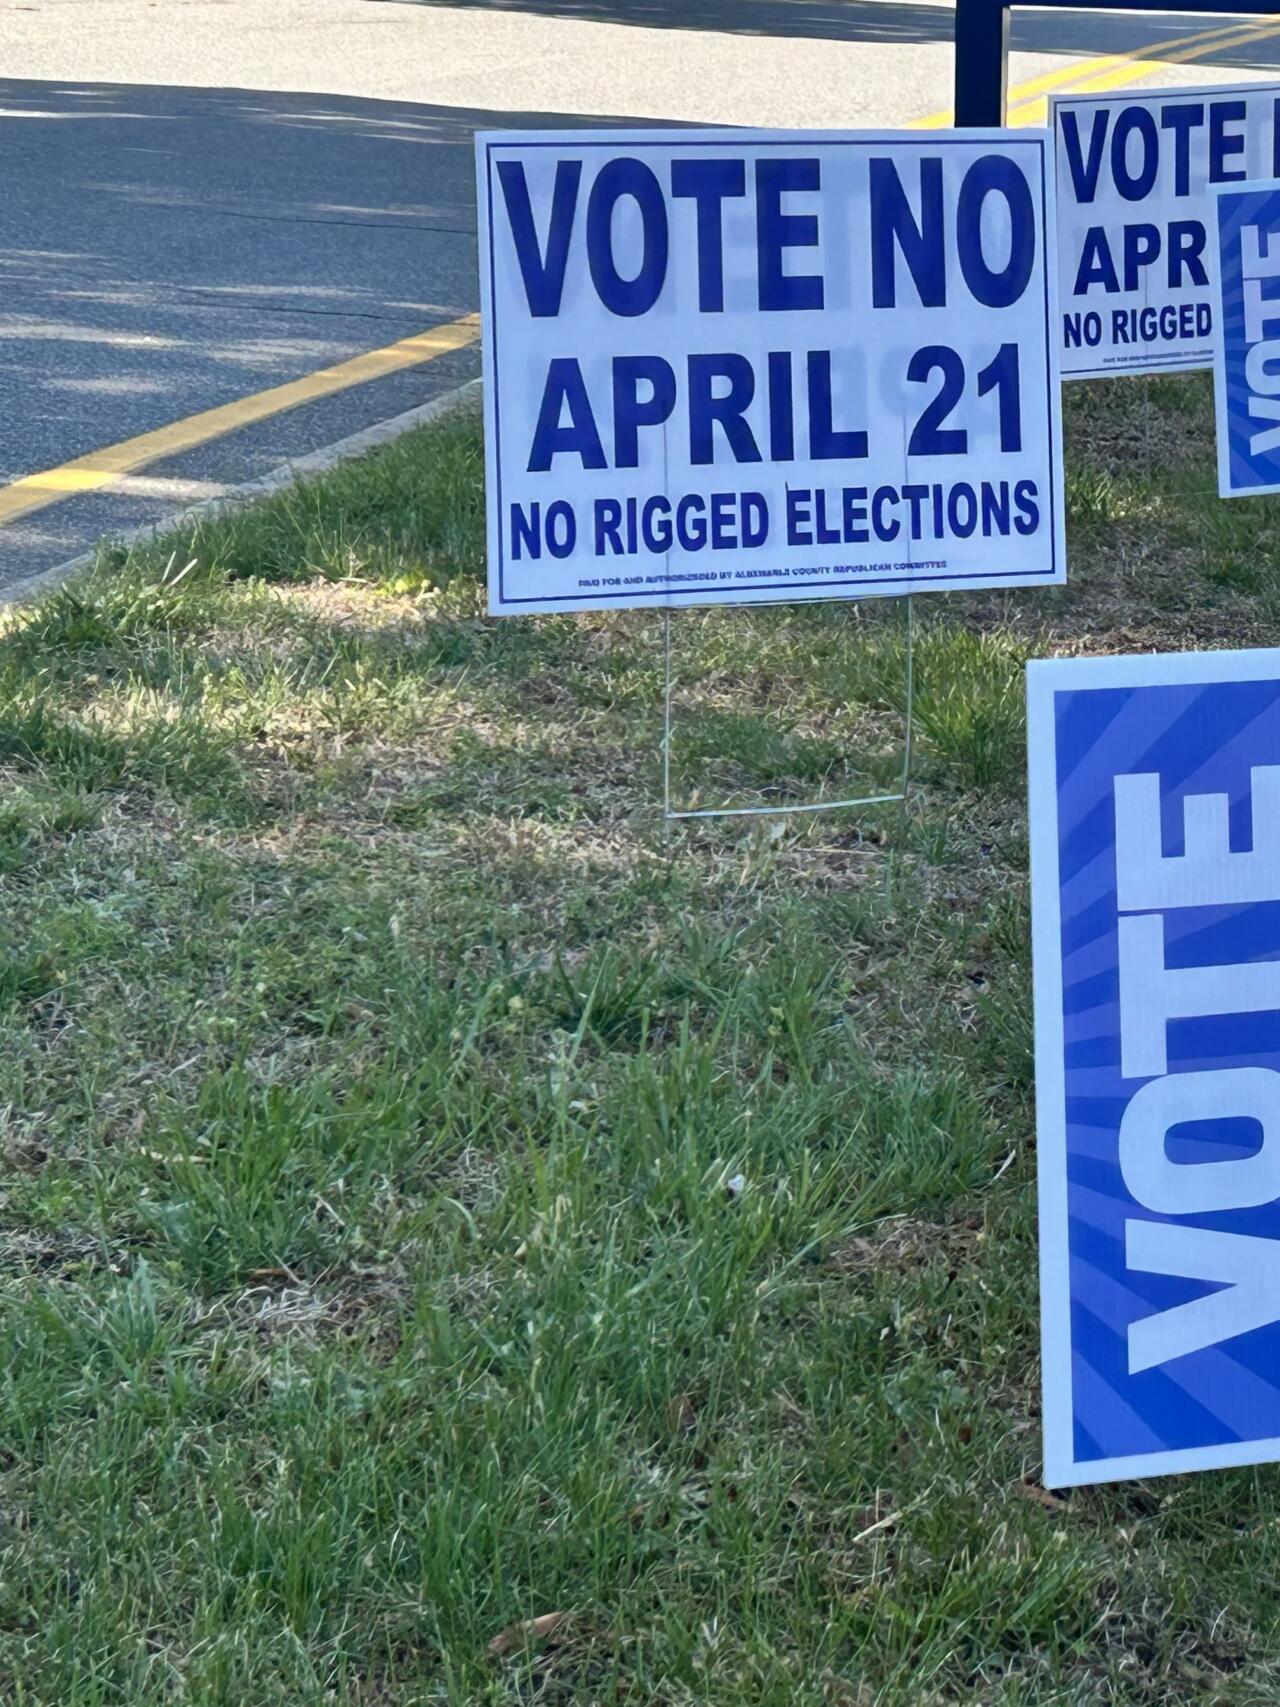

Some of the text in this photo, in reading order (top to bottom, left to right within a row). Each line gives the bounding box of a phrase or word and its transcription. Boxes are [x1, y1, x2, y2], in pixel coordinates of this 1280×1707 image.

[1060, 101, 1246, 203] VOTE
[496, 155, 1035, 317] VOTE NO
[1073, 220, 1209, 295] APR
[1064, 303, 1212, 348] NO RIGGED
[527, 343, 1021, 472] APRIL 21
[511, 480, 1039, 560] NO RIGGED ELECTIONS
